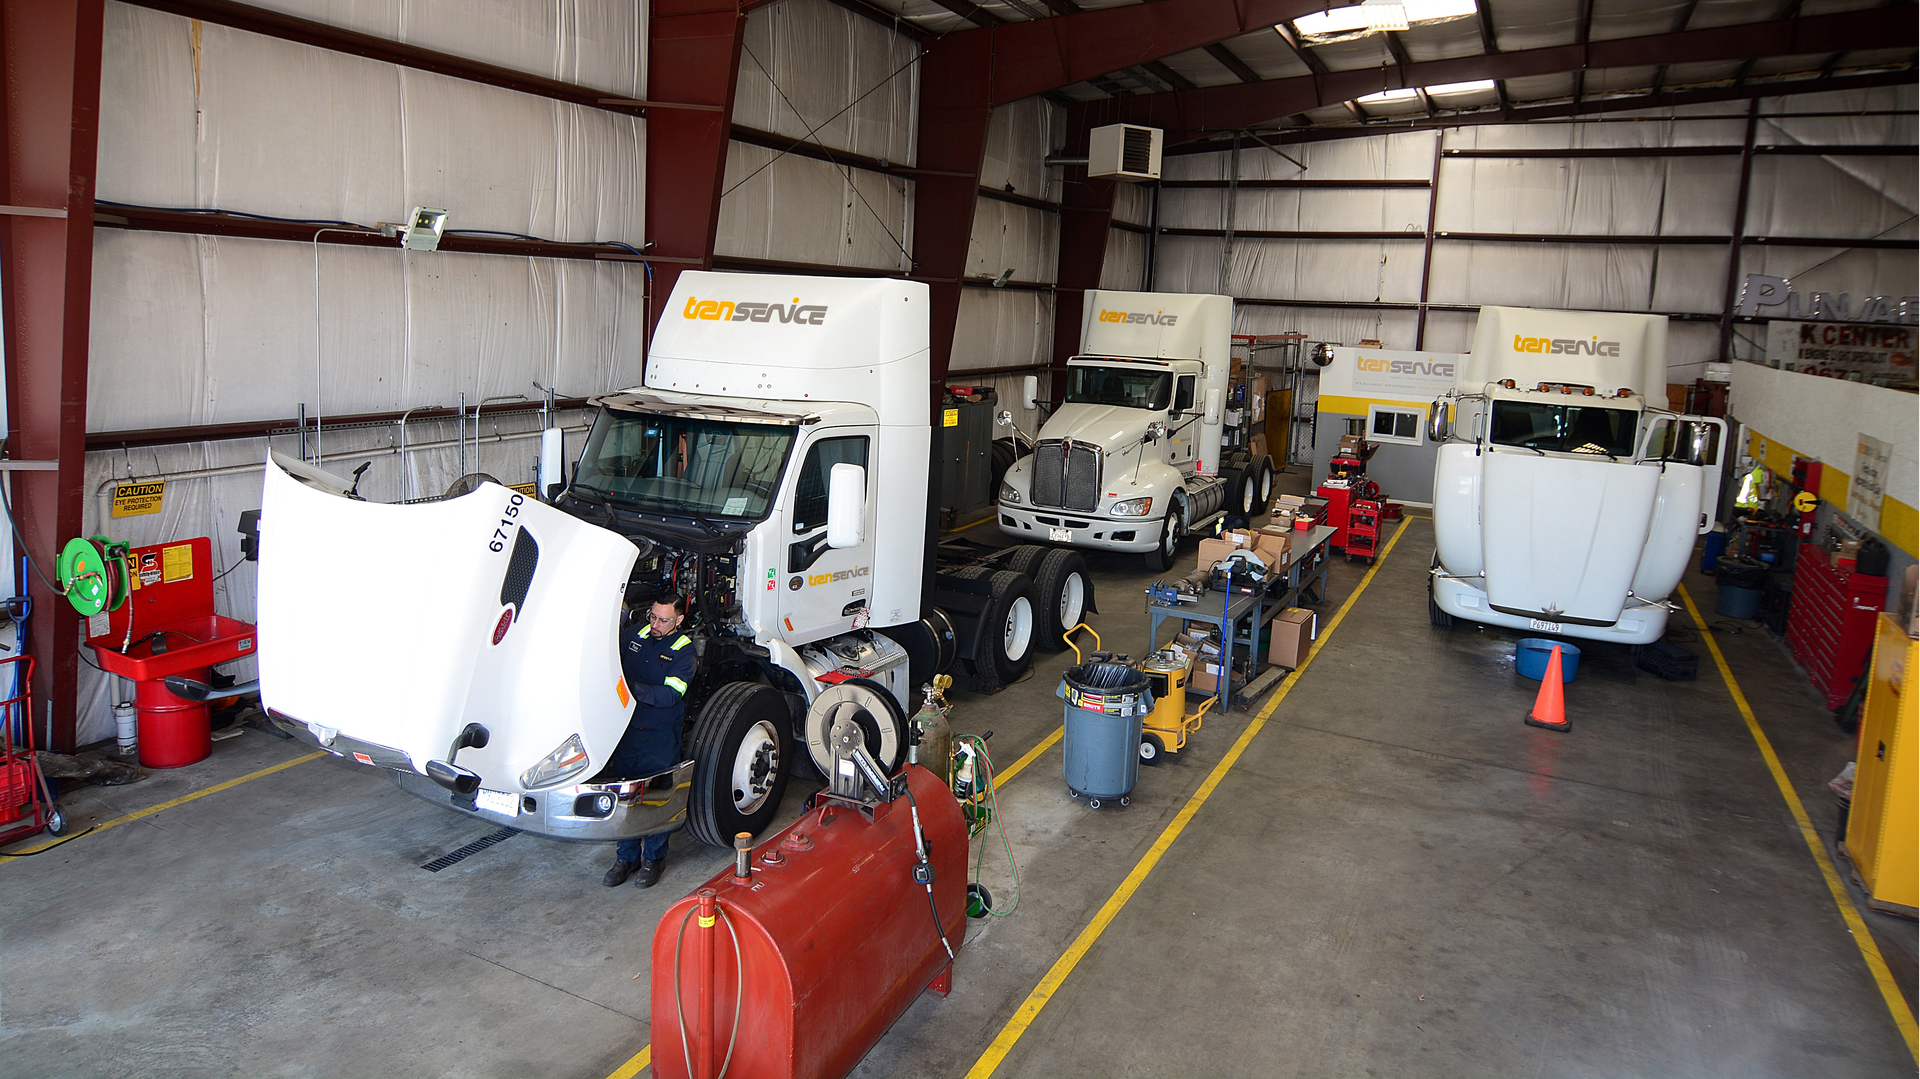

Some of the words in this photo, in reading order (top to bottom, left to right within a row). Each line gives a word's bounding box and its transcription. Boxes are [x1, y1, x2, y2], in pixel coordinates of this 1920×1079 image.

[1823, 325, 1909, 348] CENTER
[118, 484, 164, 497] CAUTION
[127, 495, 162, 505] PROTECTION
[123, 503, 152, 511] REQUIRED
[489, 493, 524, 552] 67150
